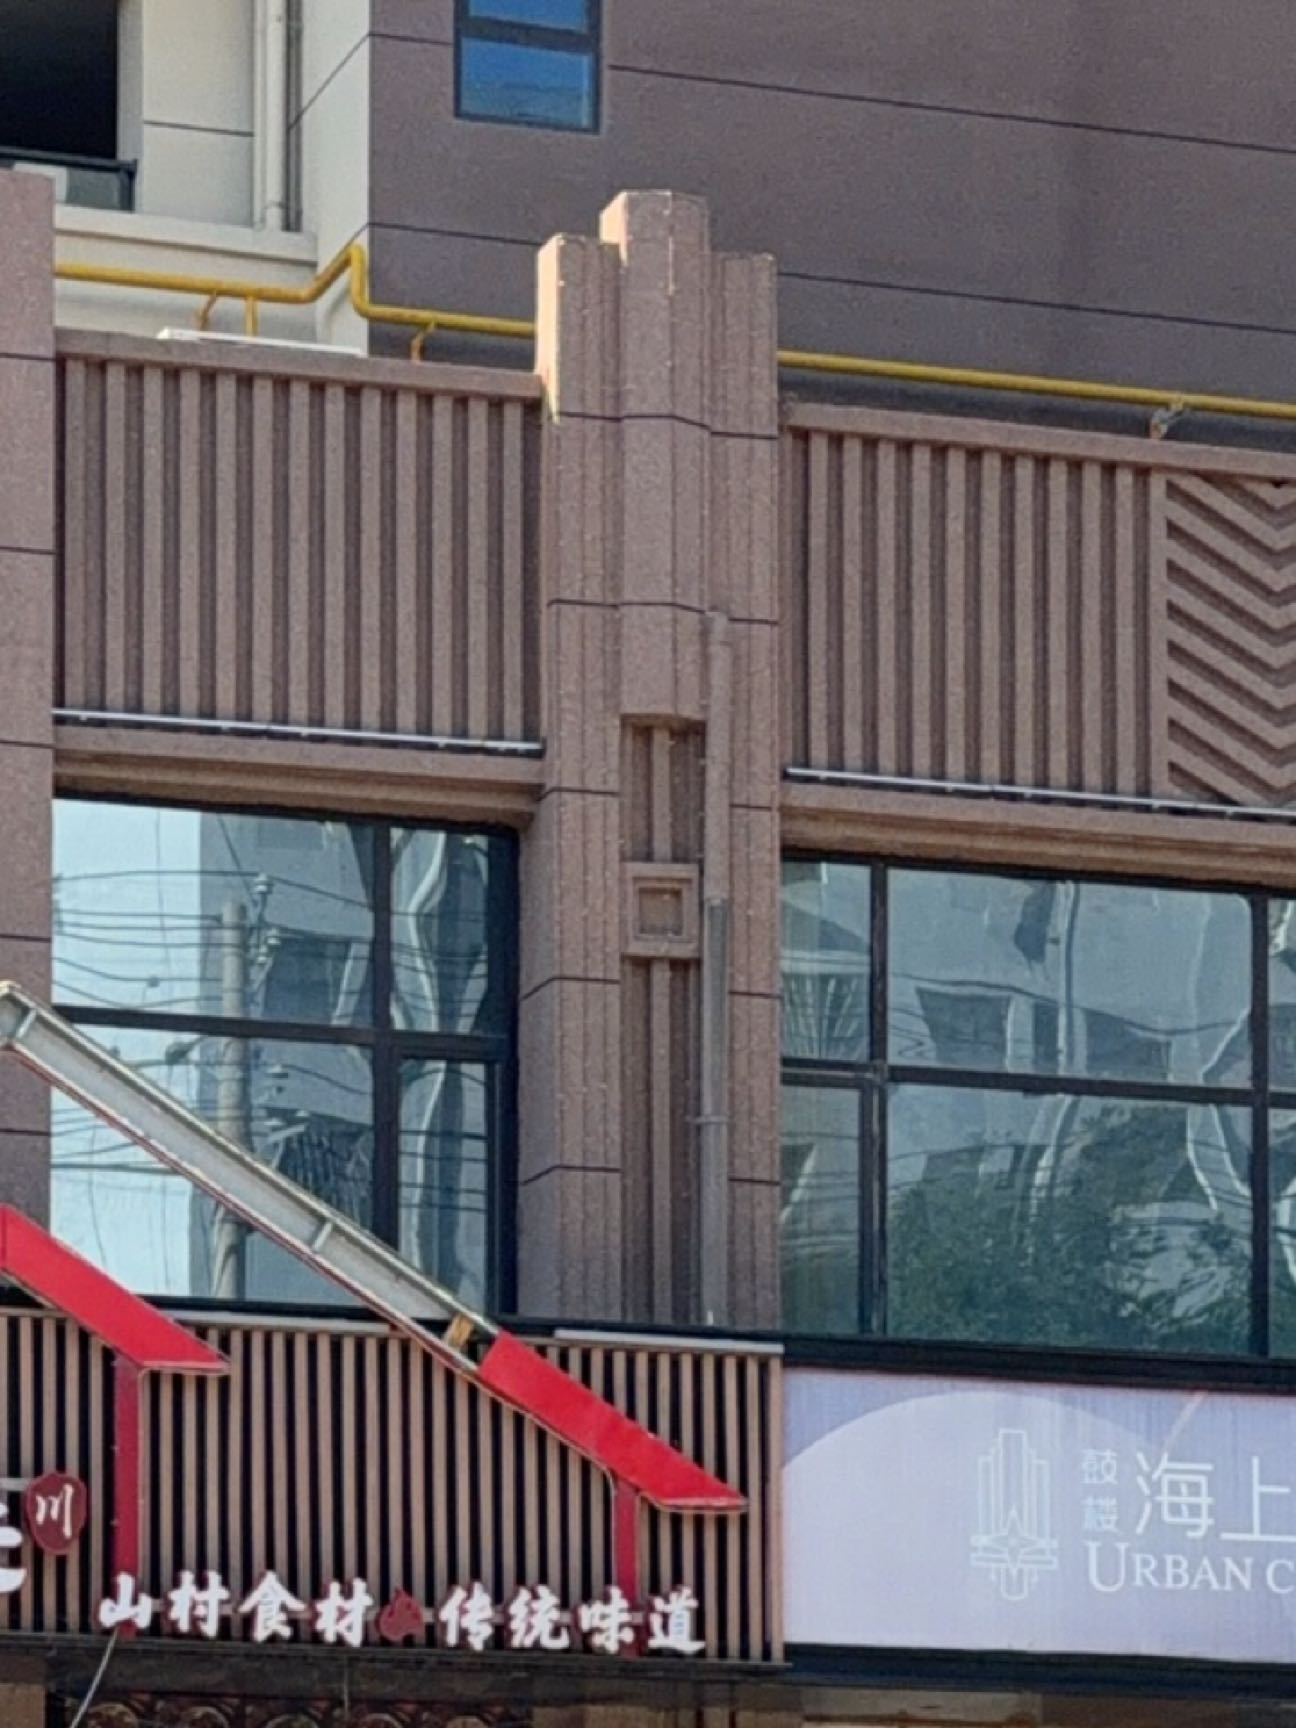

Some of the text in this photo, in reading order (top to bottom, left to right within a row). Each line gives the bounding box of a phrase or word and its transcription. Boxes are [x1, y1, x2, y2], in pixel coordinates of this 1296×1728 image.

[36, 1484, 73, 1540] 川
[1135, 1451, 1296, 1543] 海上
[1084, 1541, 1254, 1593] URBAN
[98, 1569, 706, 1654] 山村食材 传统味道
